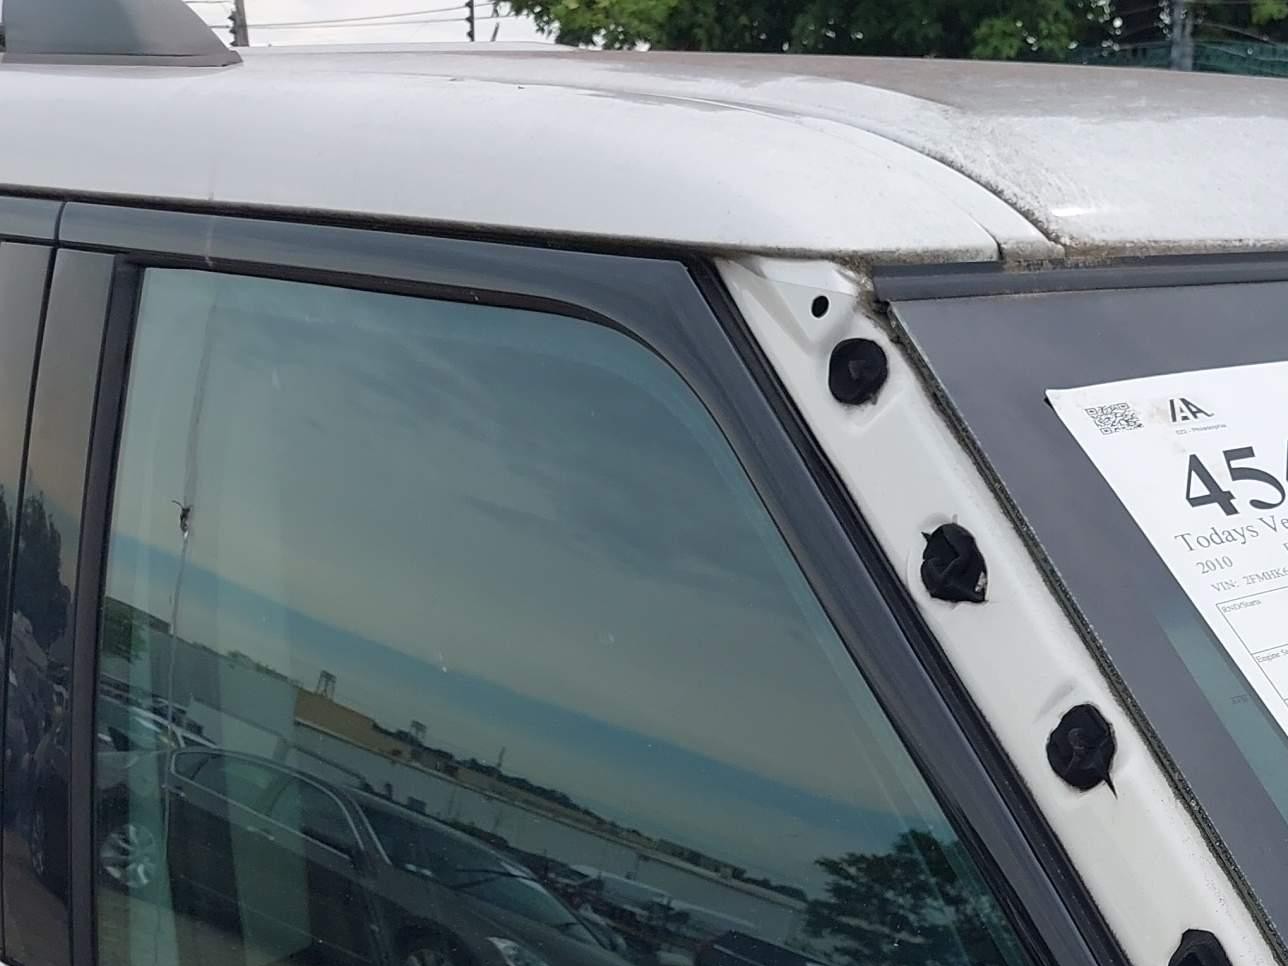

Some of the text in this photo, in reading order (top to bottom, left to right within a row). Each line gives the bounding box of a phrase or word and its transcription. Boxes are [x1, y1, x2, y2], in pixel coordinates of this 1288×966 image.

[1174, 524, 1259, 552] Todays
[1195, 555, 1233, 575] 2010
[1211, 579, 1239, 592] VIN:
